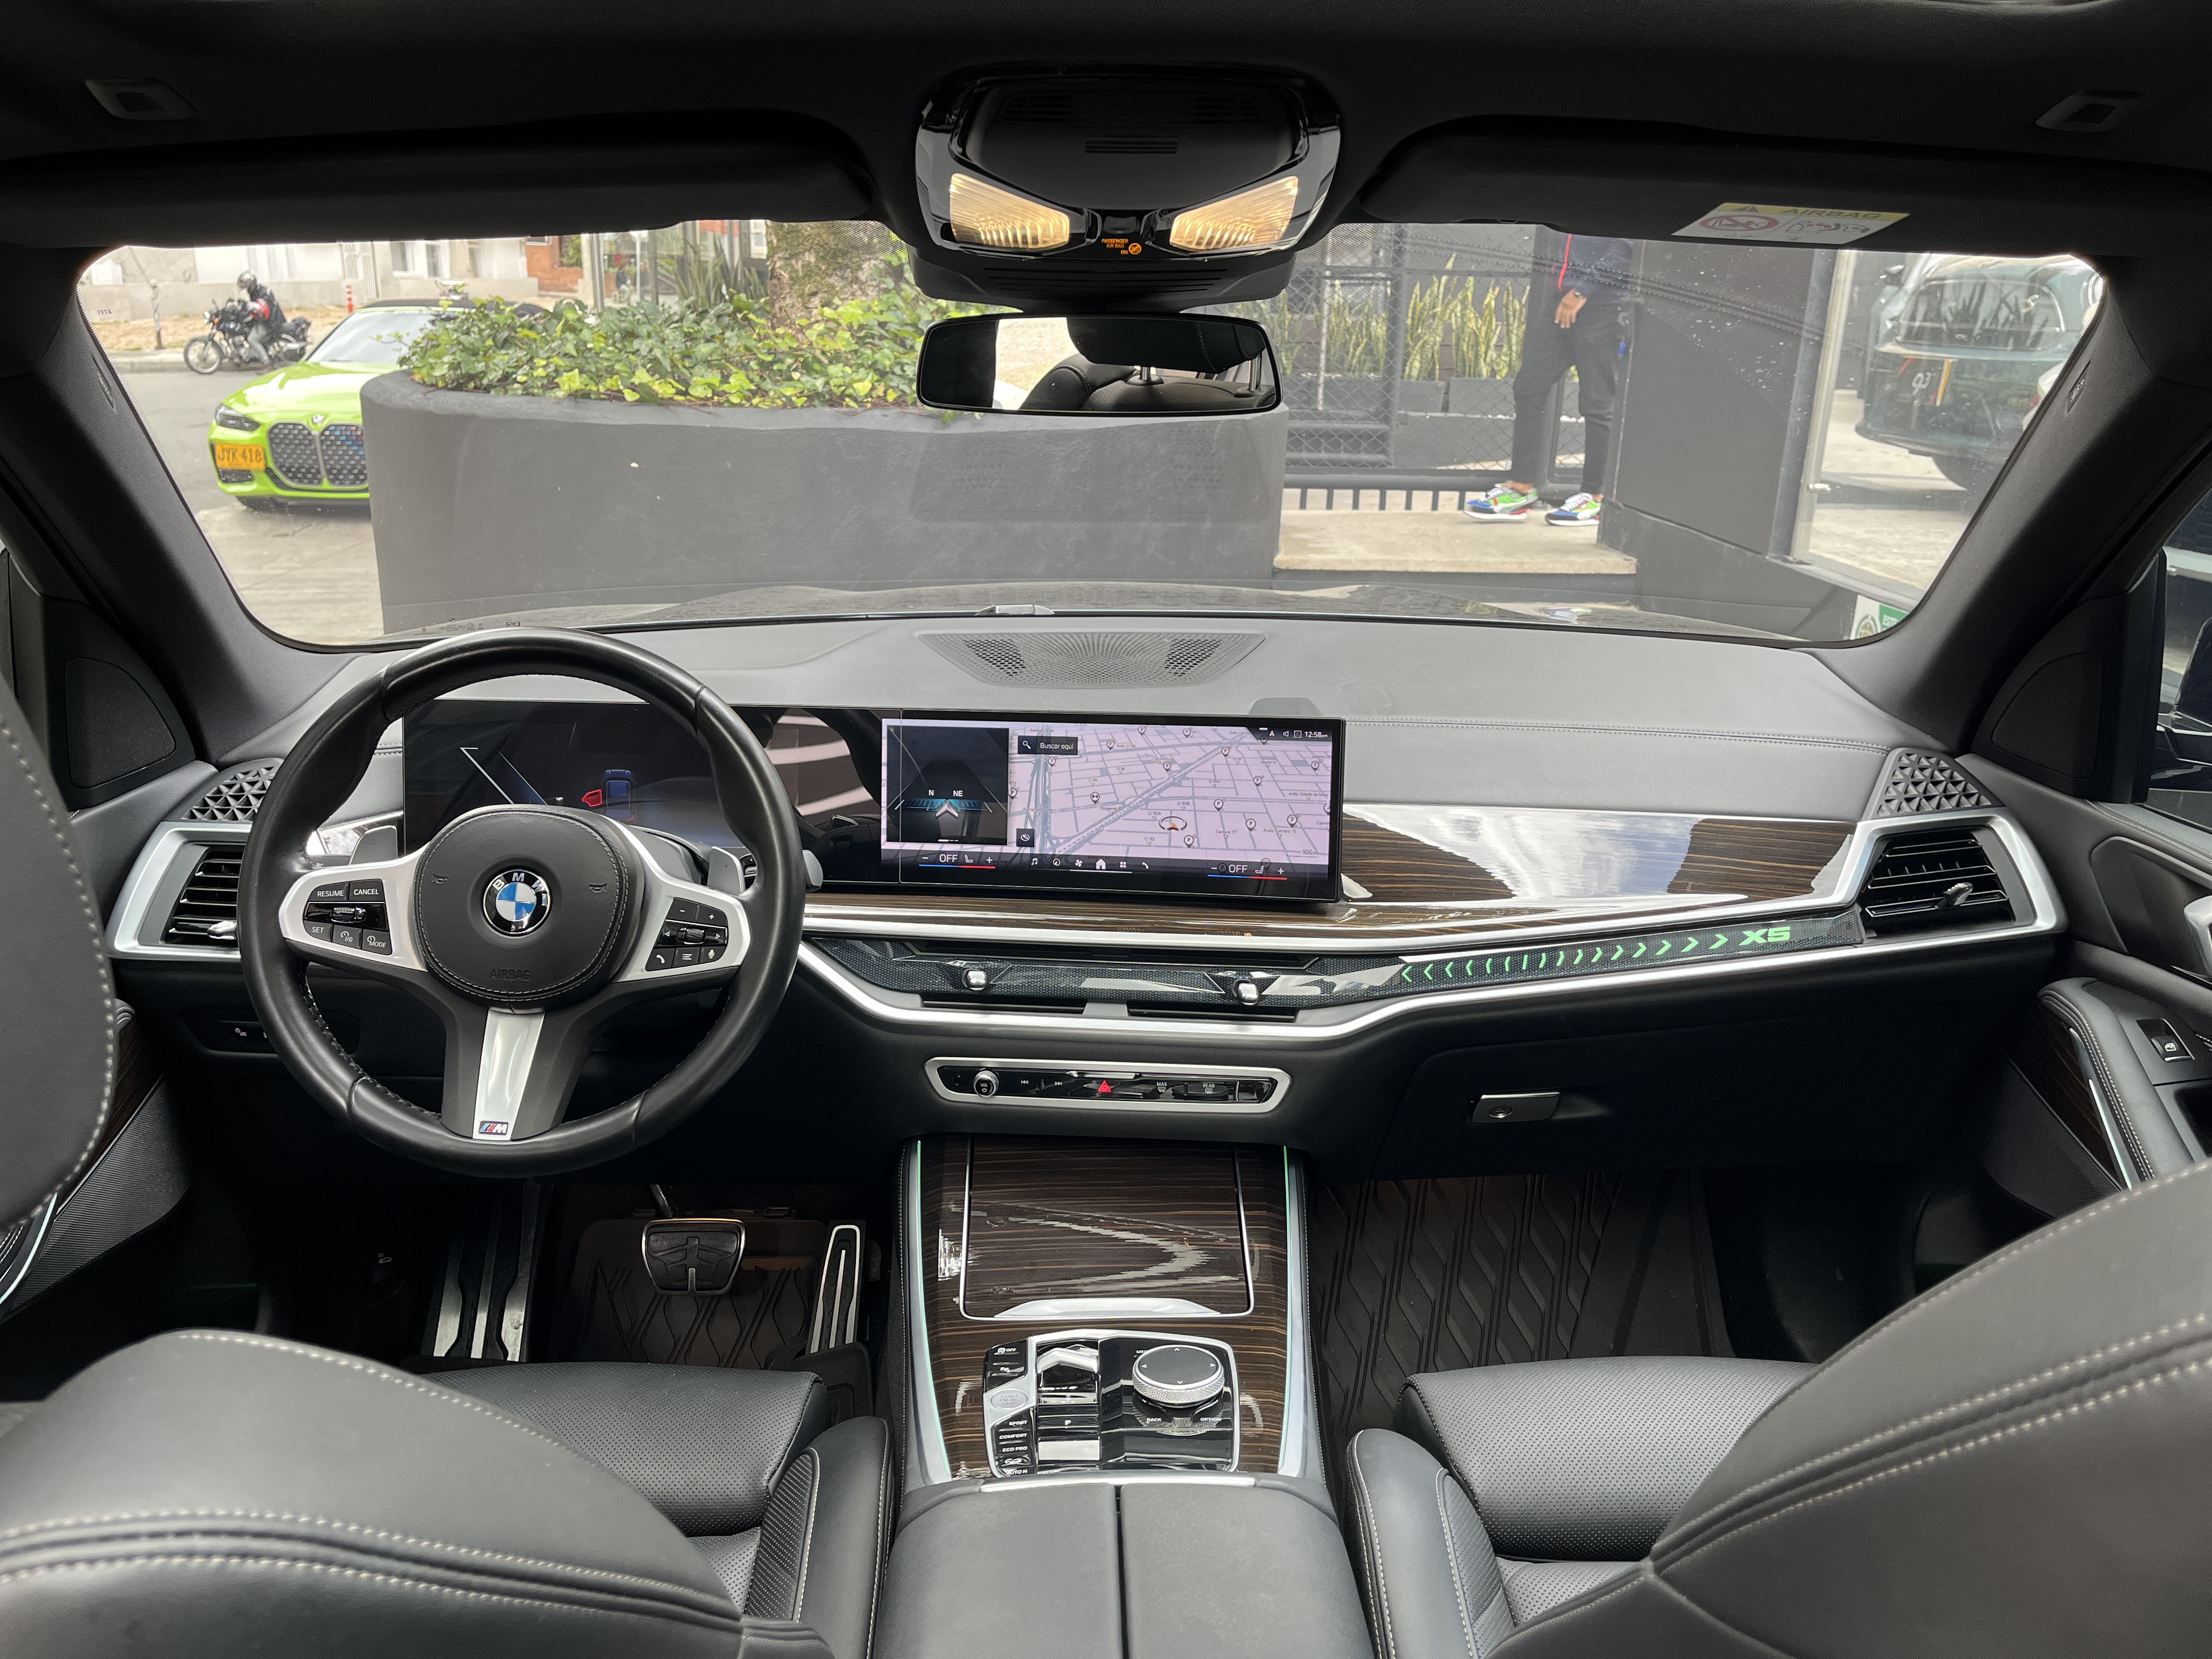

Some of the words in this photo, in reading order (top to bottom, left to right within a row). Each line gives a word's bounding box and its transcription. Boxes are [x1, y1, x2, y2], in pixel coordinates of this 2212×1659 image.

[1780, 208, 1882, 219] AIRBAG
[939, 854, 958, 862] OFF
[1228, 864, 1248, 873] OFF
[492, 872, 546, 893] BMW
[1738, 926, 1791, 946] X5
[490, 968, 530, 981] AIRBAG
